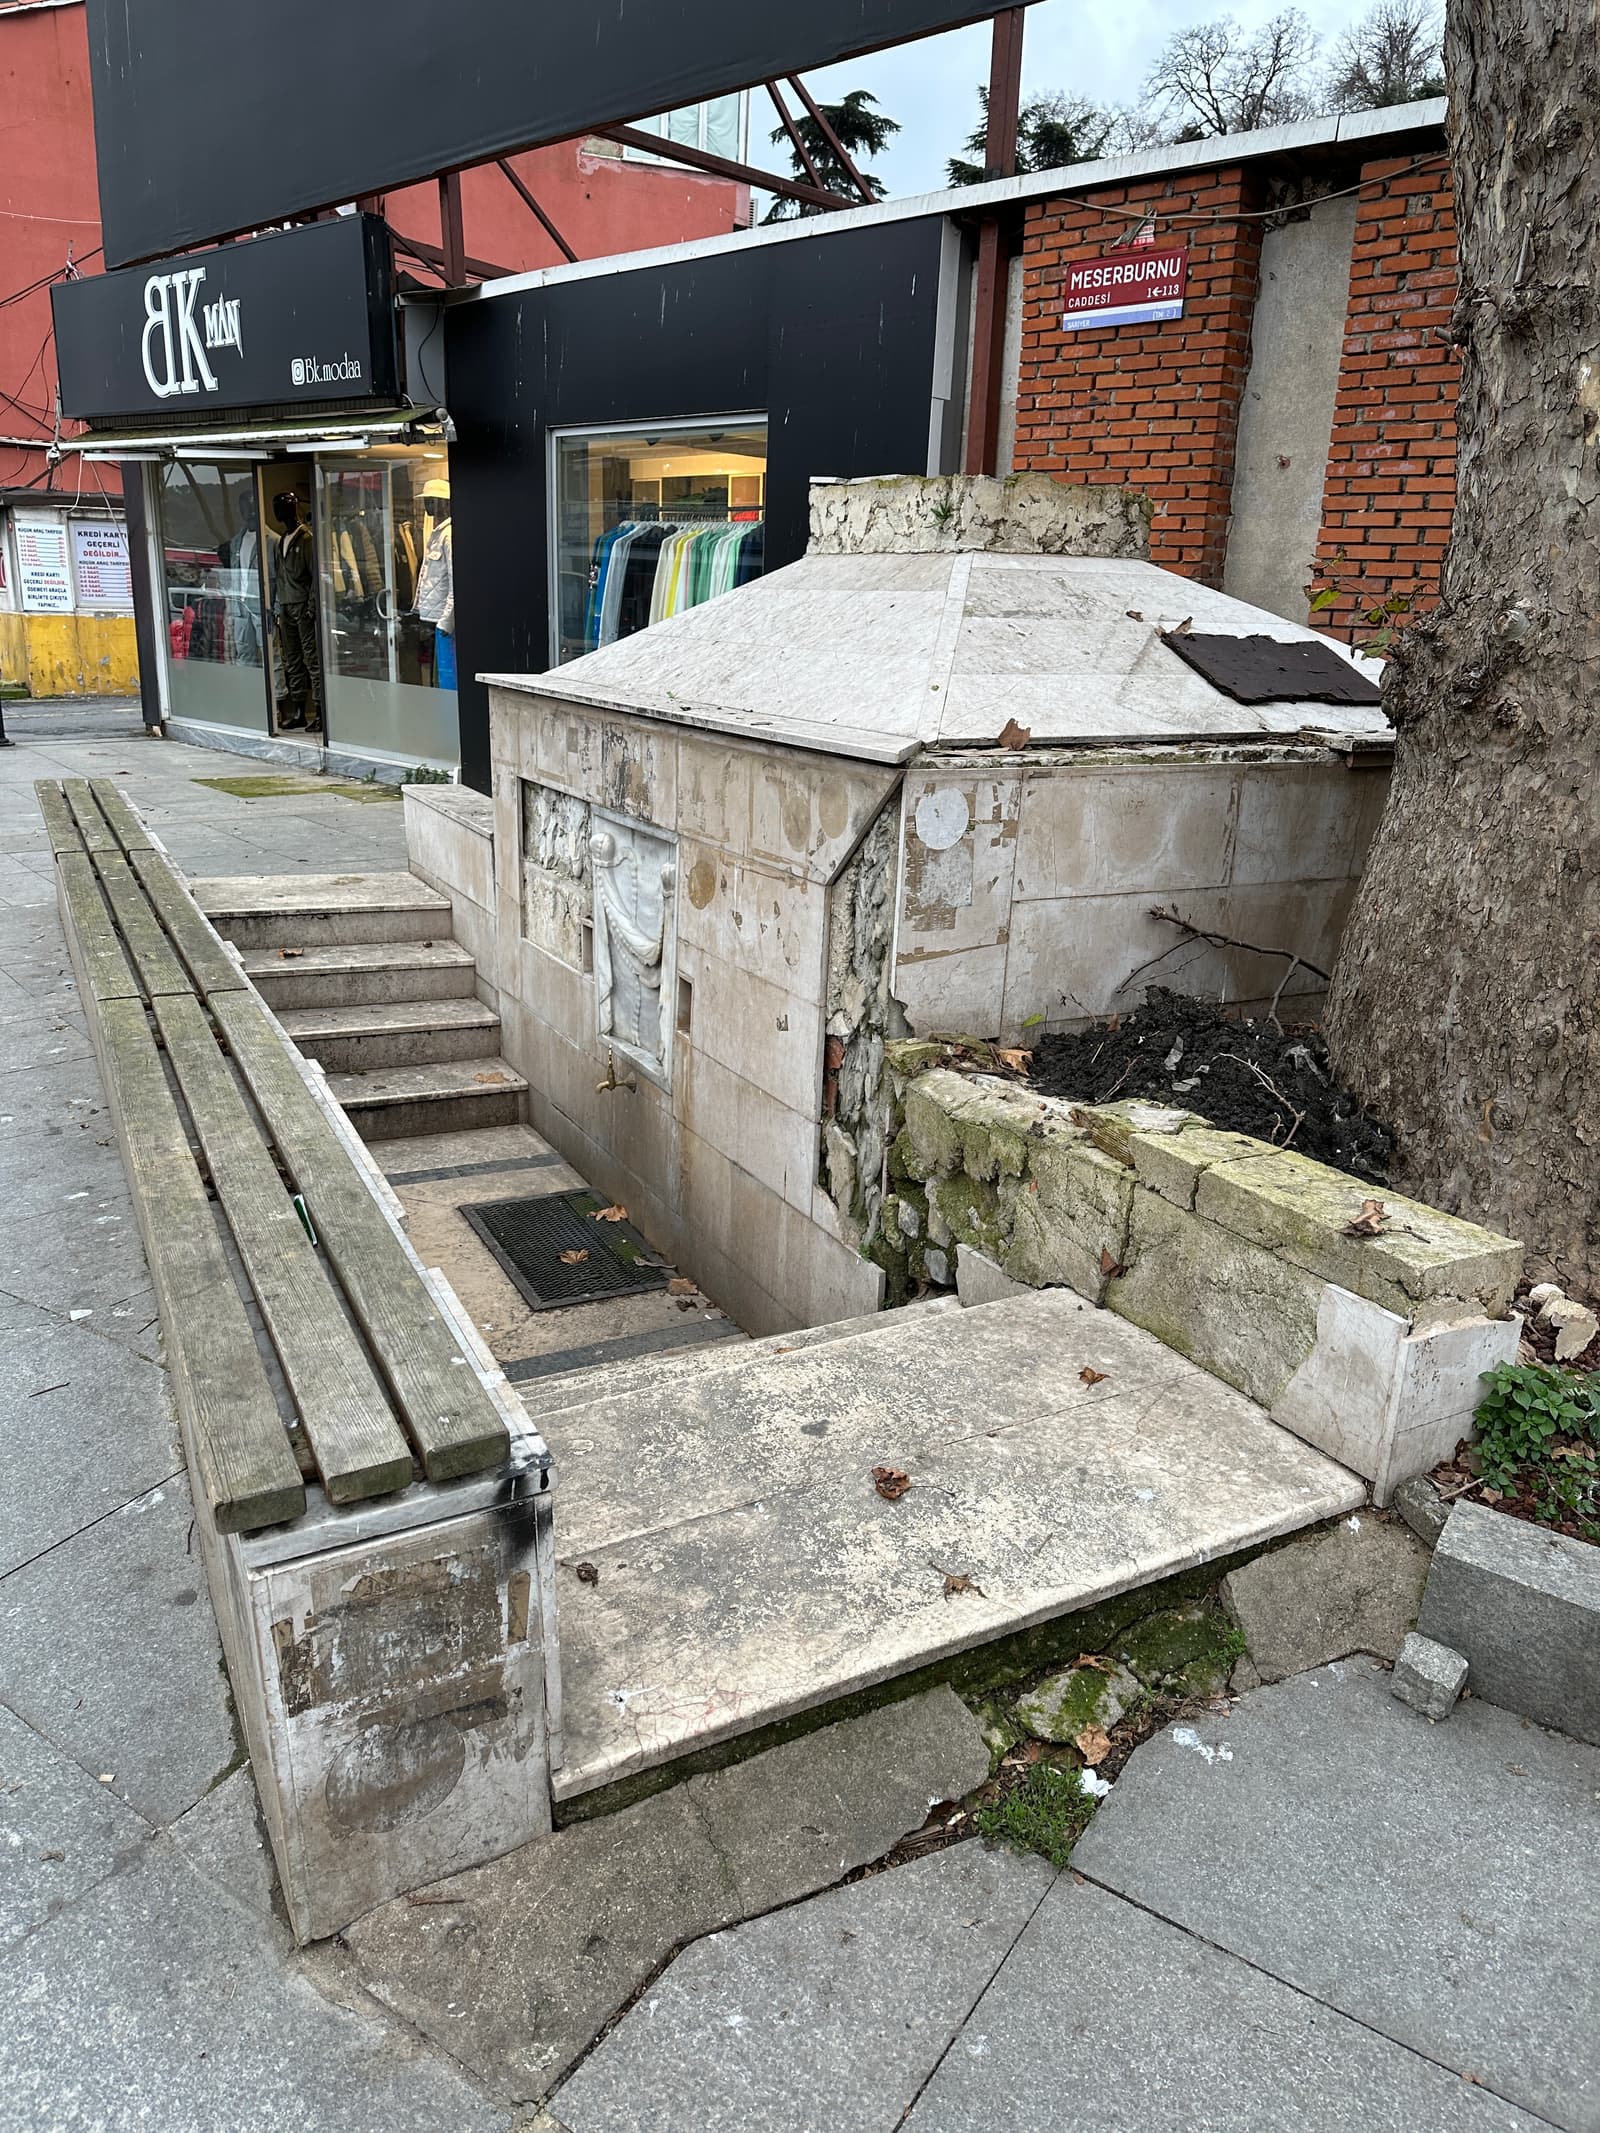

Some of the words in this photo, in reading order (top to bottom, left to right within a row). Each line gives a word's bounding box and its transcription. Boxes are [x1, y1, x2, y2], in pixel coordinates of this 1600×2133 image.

[1070, 257, 1181, 290] MESERBURNU
[1068, 291, 1111, 308] CADDESİ
[304, 351, 362, 384] Bk.modaa
[77, 530, 102, 538] KREDİ
[87, 541, 120, 549] GEÇERLİ
